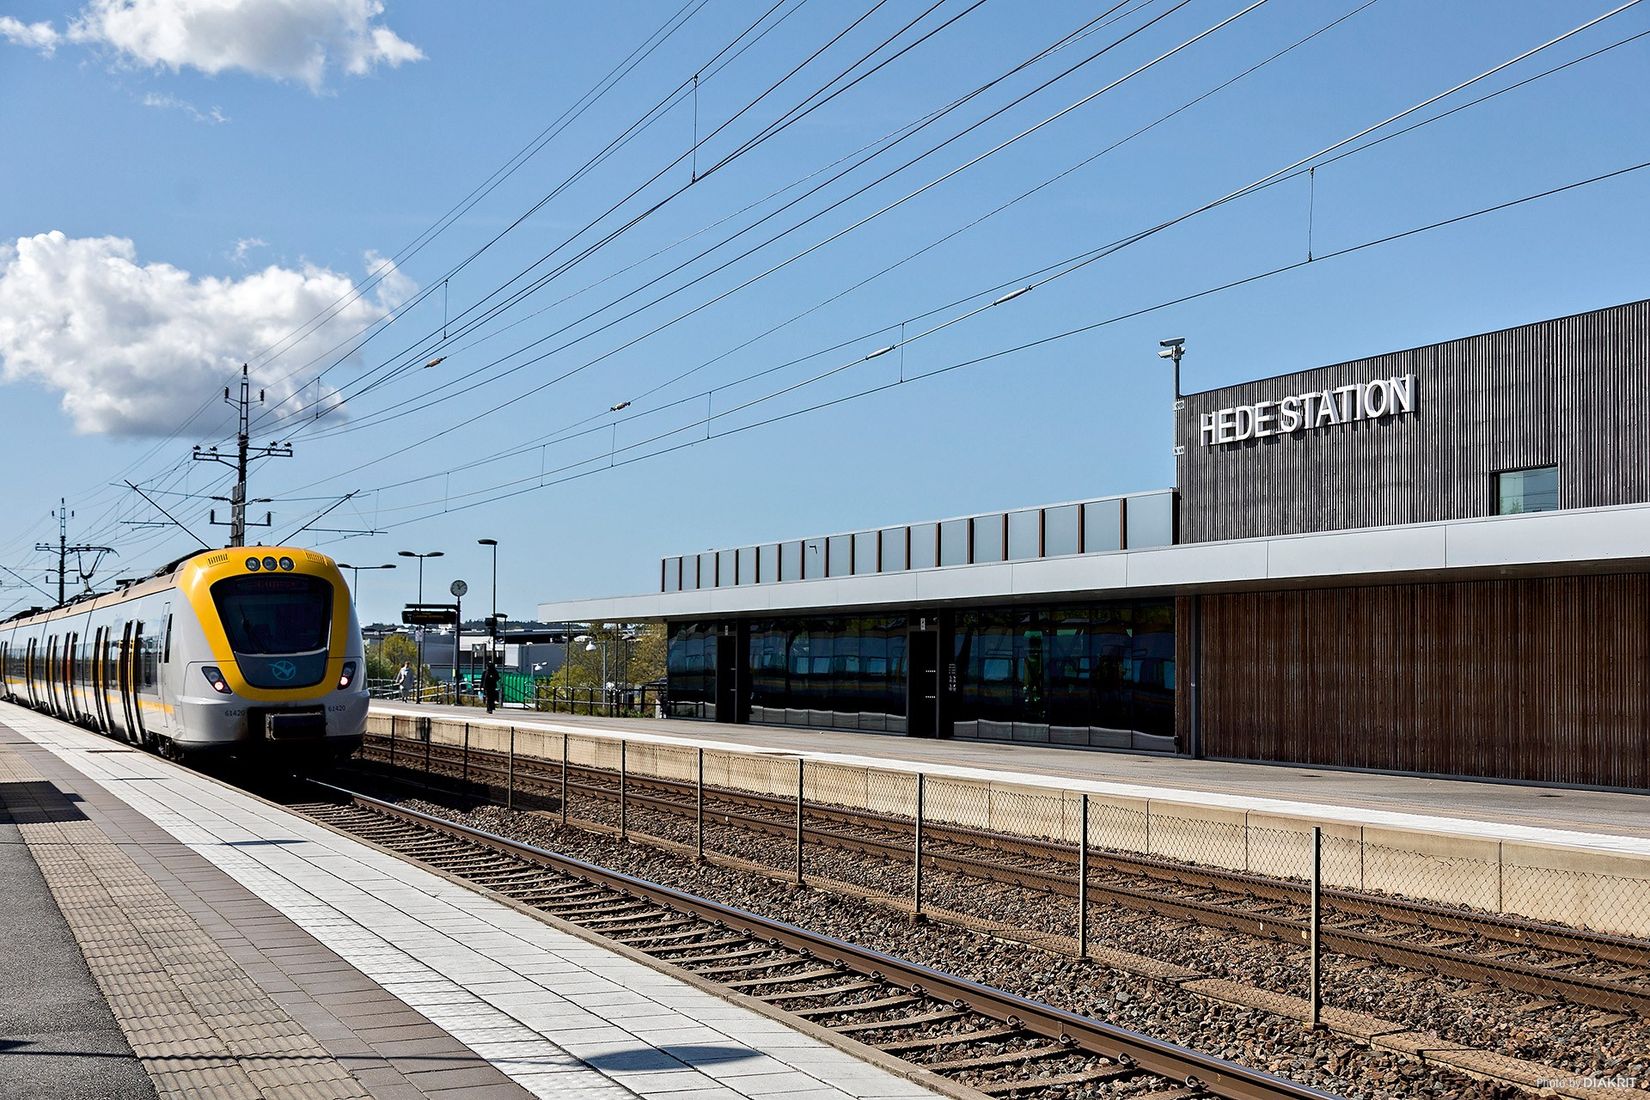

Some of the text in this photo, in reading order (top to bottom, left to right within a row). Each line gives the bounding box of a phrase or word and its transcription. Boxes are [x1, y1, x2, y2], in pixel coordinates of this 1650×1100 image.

[1200, 374, 1417, 446] HEDE STATION
[224, 709, 245, 717] 61420
